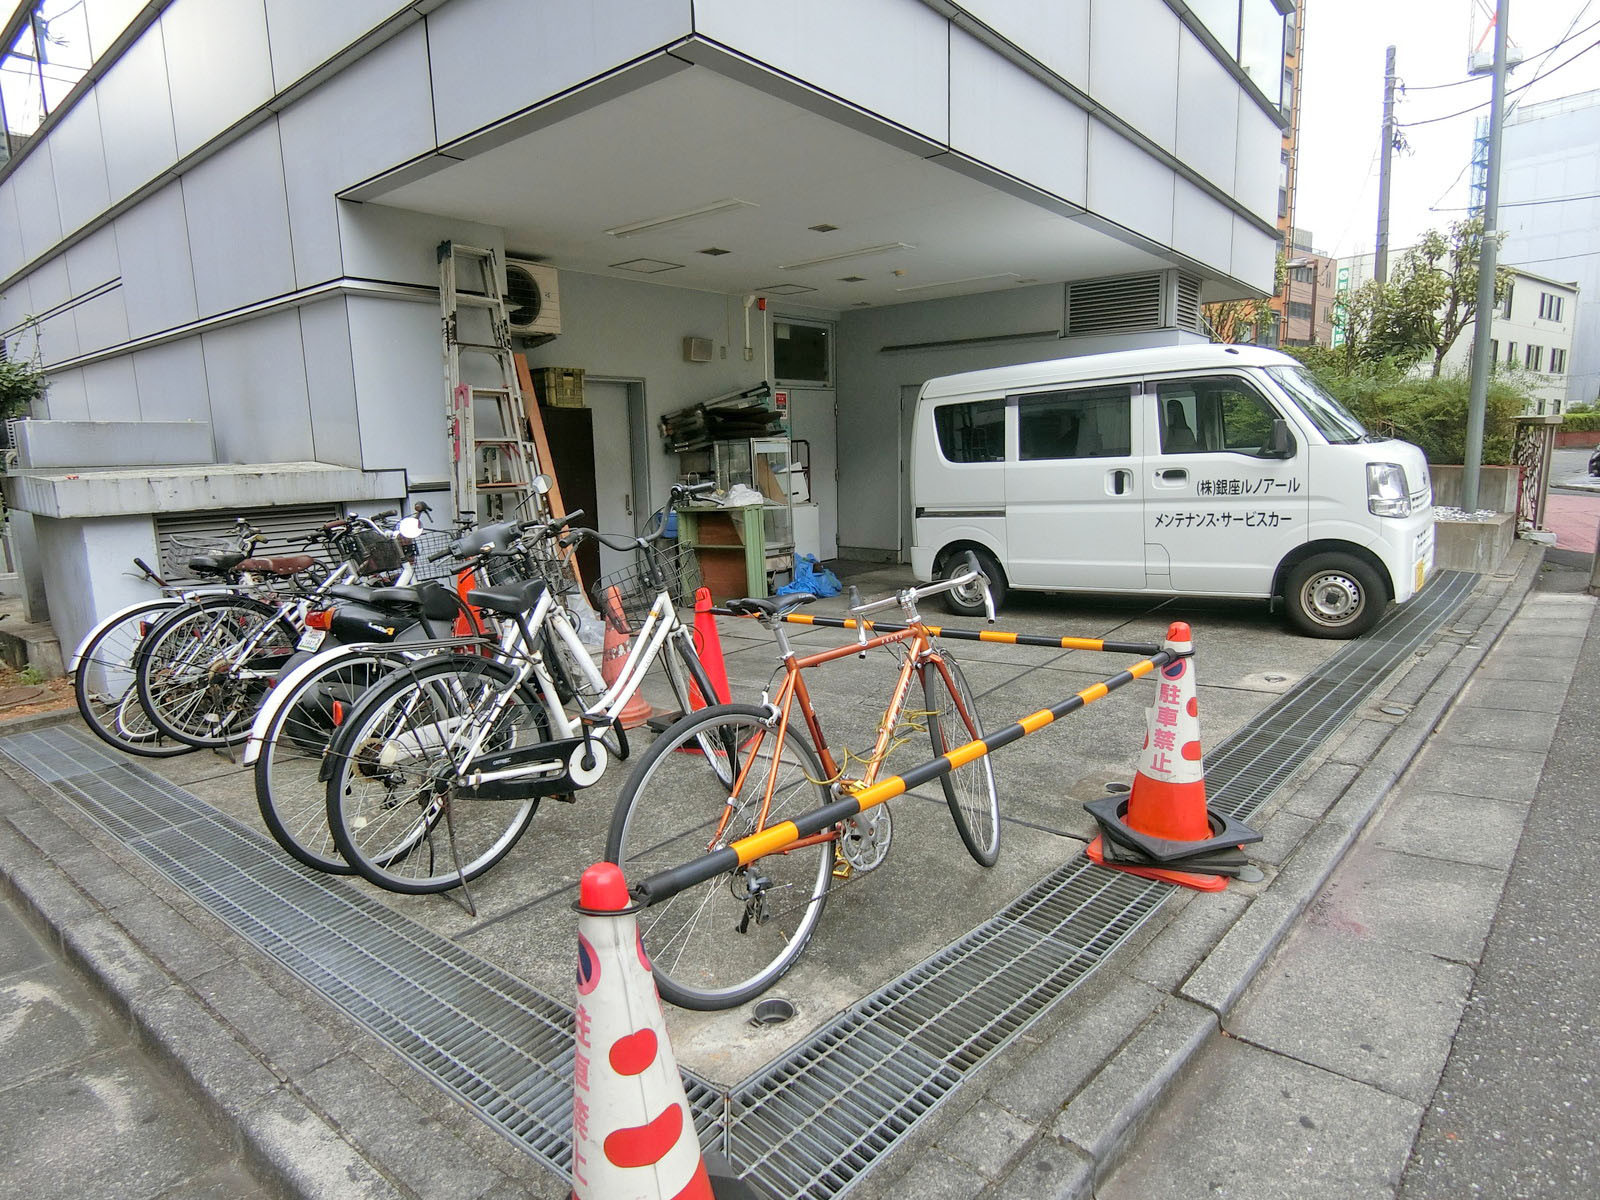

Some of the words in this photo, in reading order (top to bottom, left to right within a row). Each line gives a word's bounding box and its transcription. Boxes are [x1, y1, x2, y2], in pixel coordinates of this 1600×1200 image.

[1196, 477, 1301, 497] (株)銀座ルノアール
[1154, 511, 1292, 528] メンテナンス・サービスカー
[1149, 682, 1182, 774] 駐車禁止
